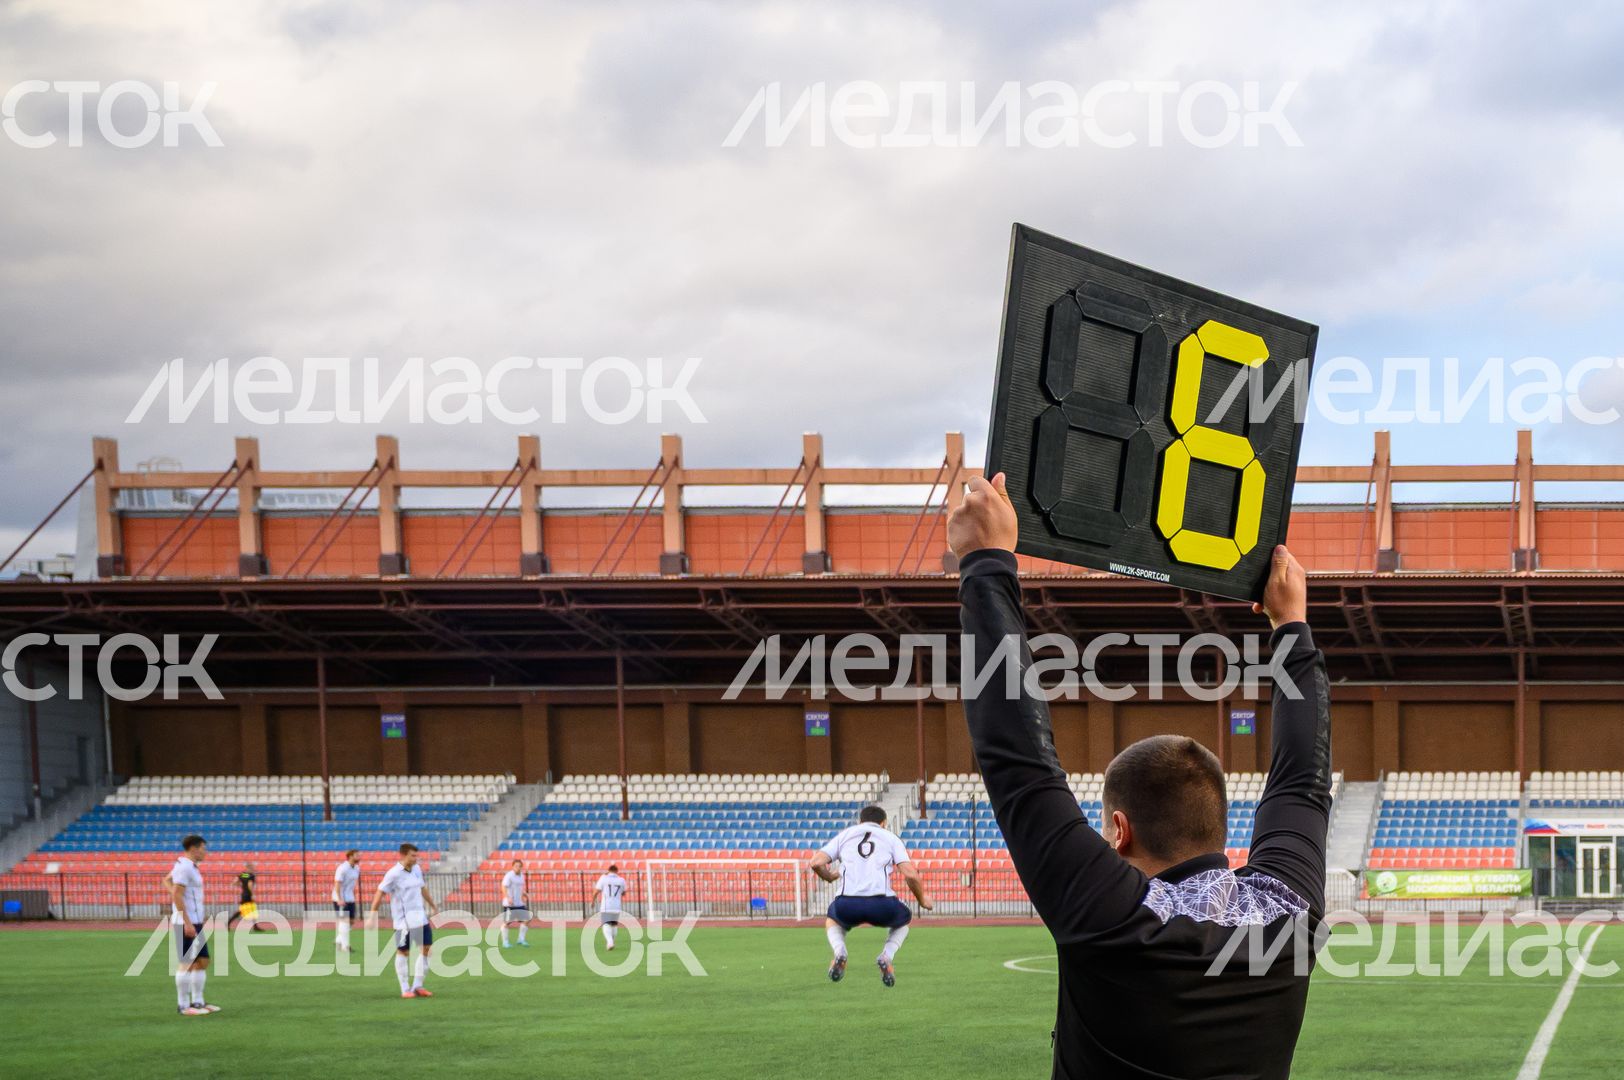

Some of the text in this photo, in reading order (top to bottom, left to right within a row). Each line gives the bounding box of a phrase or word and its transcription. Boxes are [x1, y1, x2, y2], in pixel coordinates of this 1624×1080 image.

[1156, 319, 1270, 570] 6
[1109, 562, 1170, 582] WWW.2K-SPORT.COM
[857, 831, 875, 859] 6
[608, 884, 621, 897] 17
[1475, 884, 1521, 893] ОБЛАСТИ
